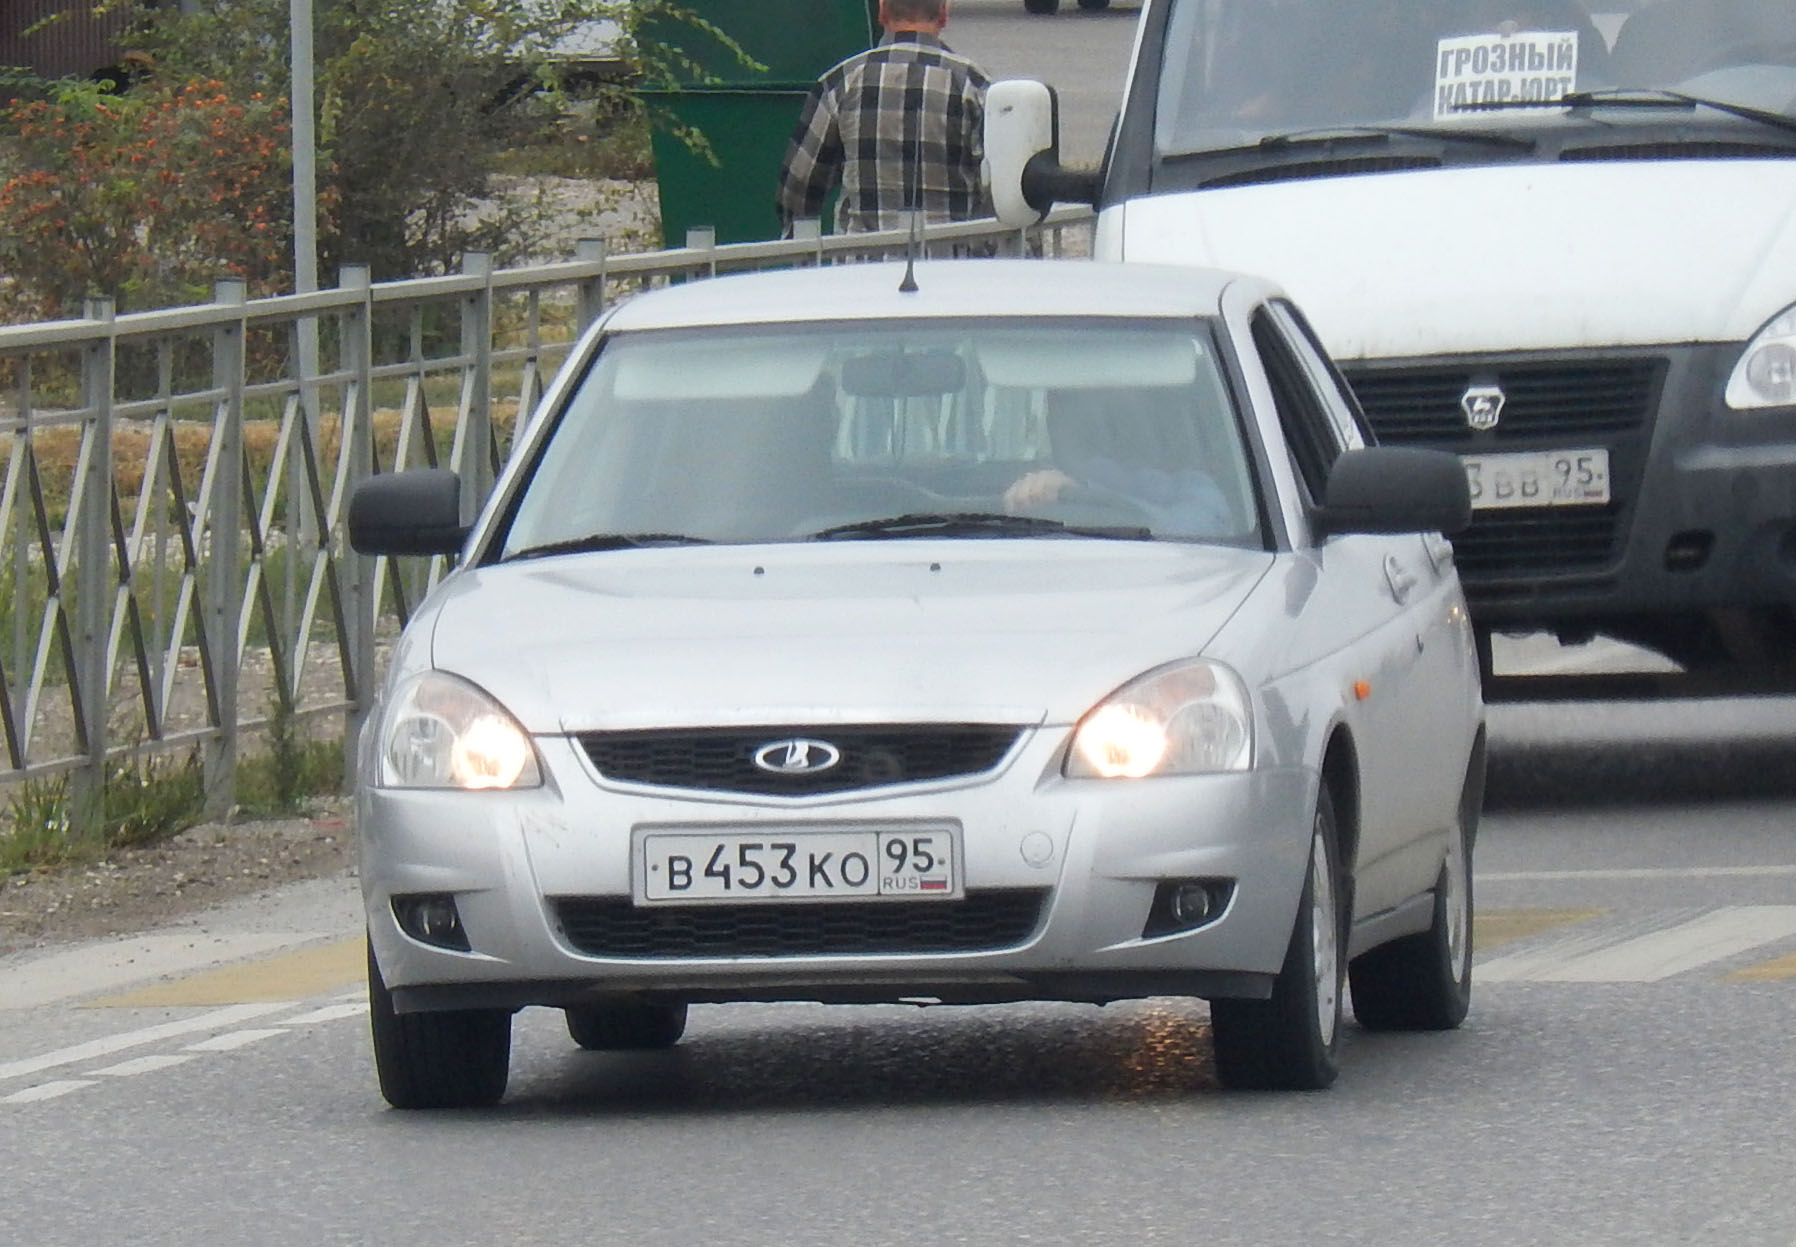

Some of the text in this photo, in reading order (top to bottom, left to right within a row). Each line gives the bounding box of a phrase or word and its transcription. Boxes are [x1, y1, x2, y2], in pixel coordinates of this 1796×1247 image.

[1440, 38, 1573, 79] ГРОЗНЫЙ
[1555, 457, 1593, 486] 95
[885, 838, 934, 873] 95
[883, 876, 918, 891] RUS
